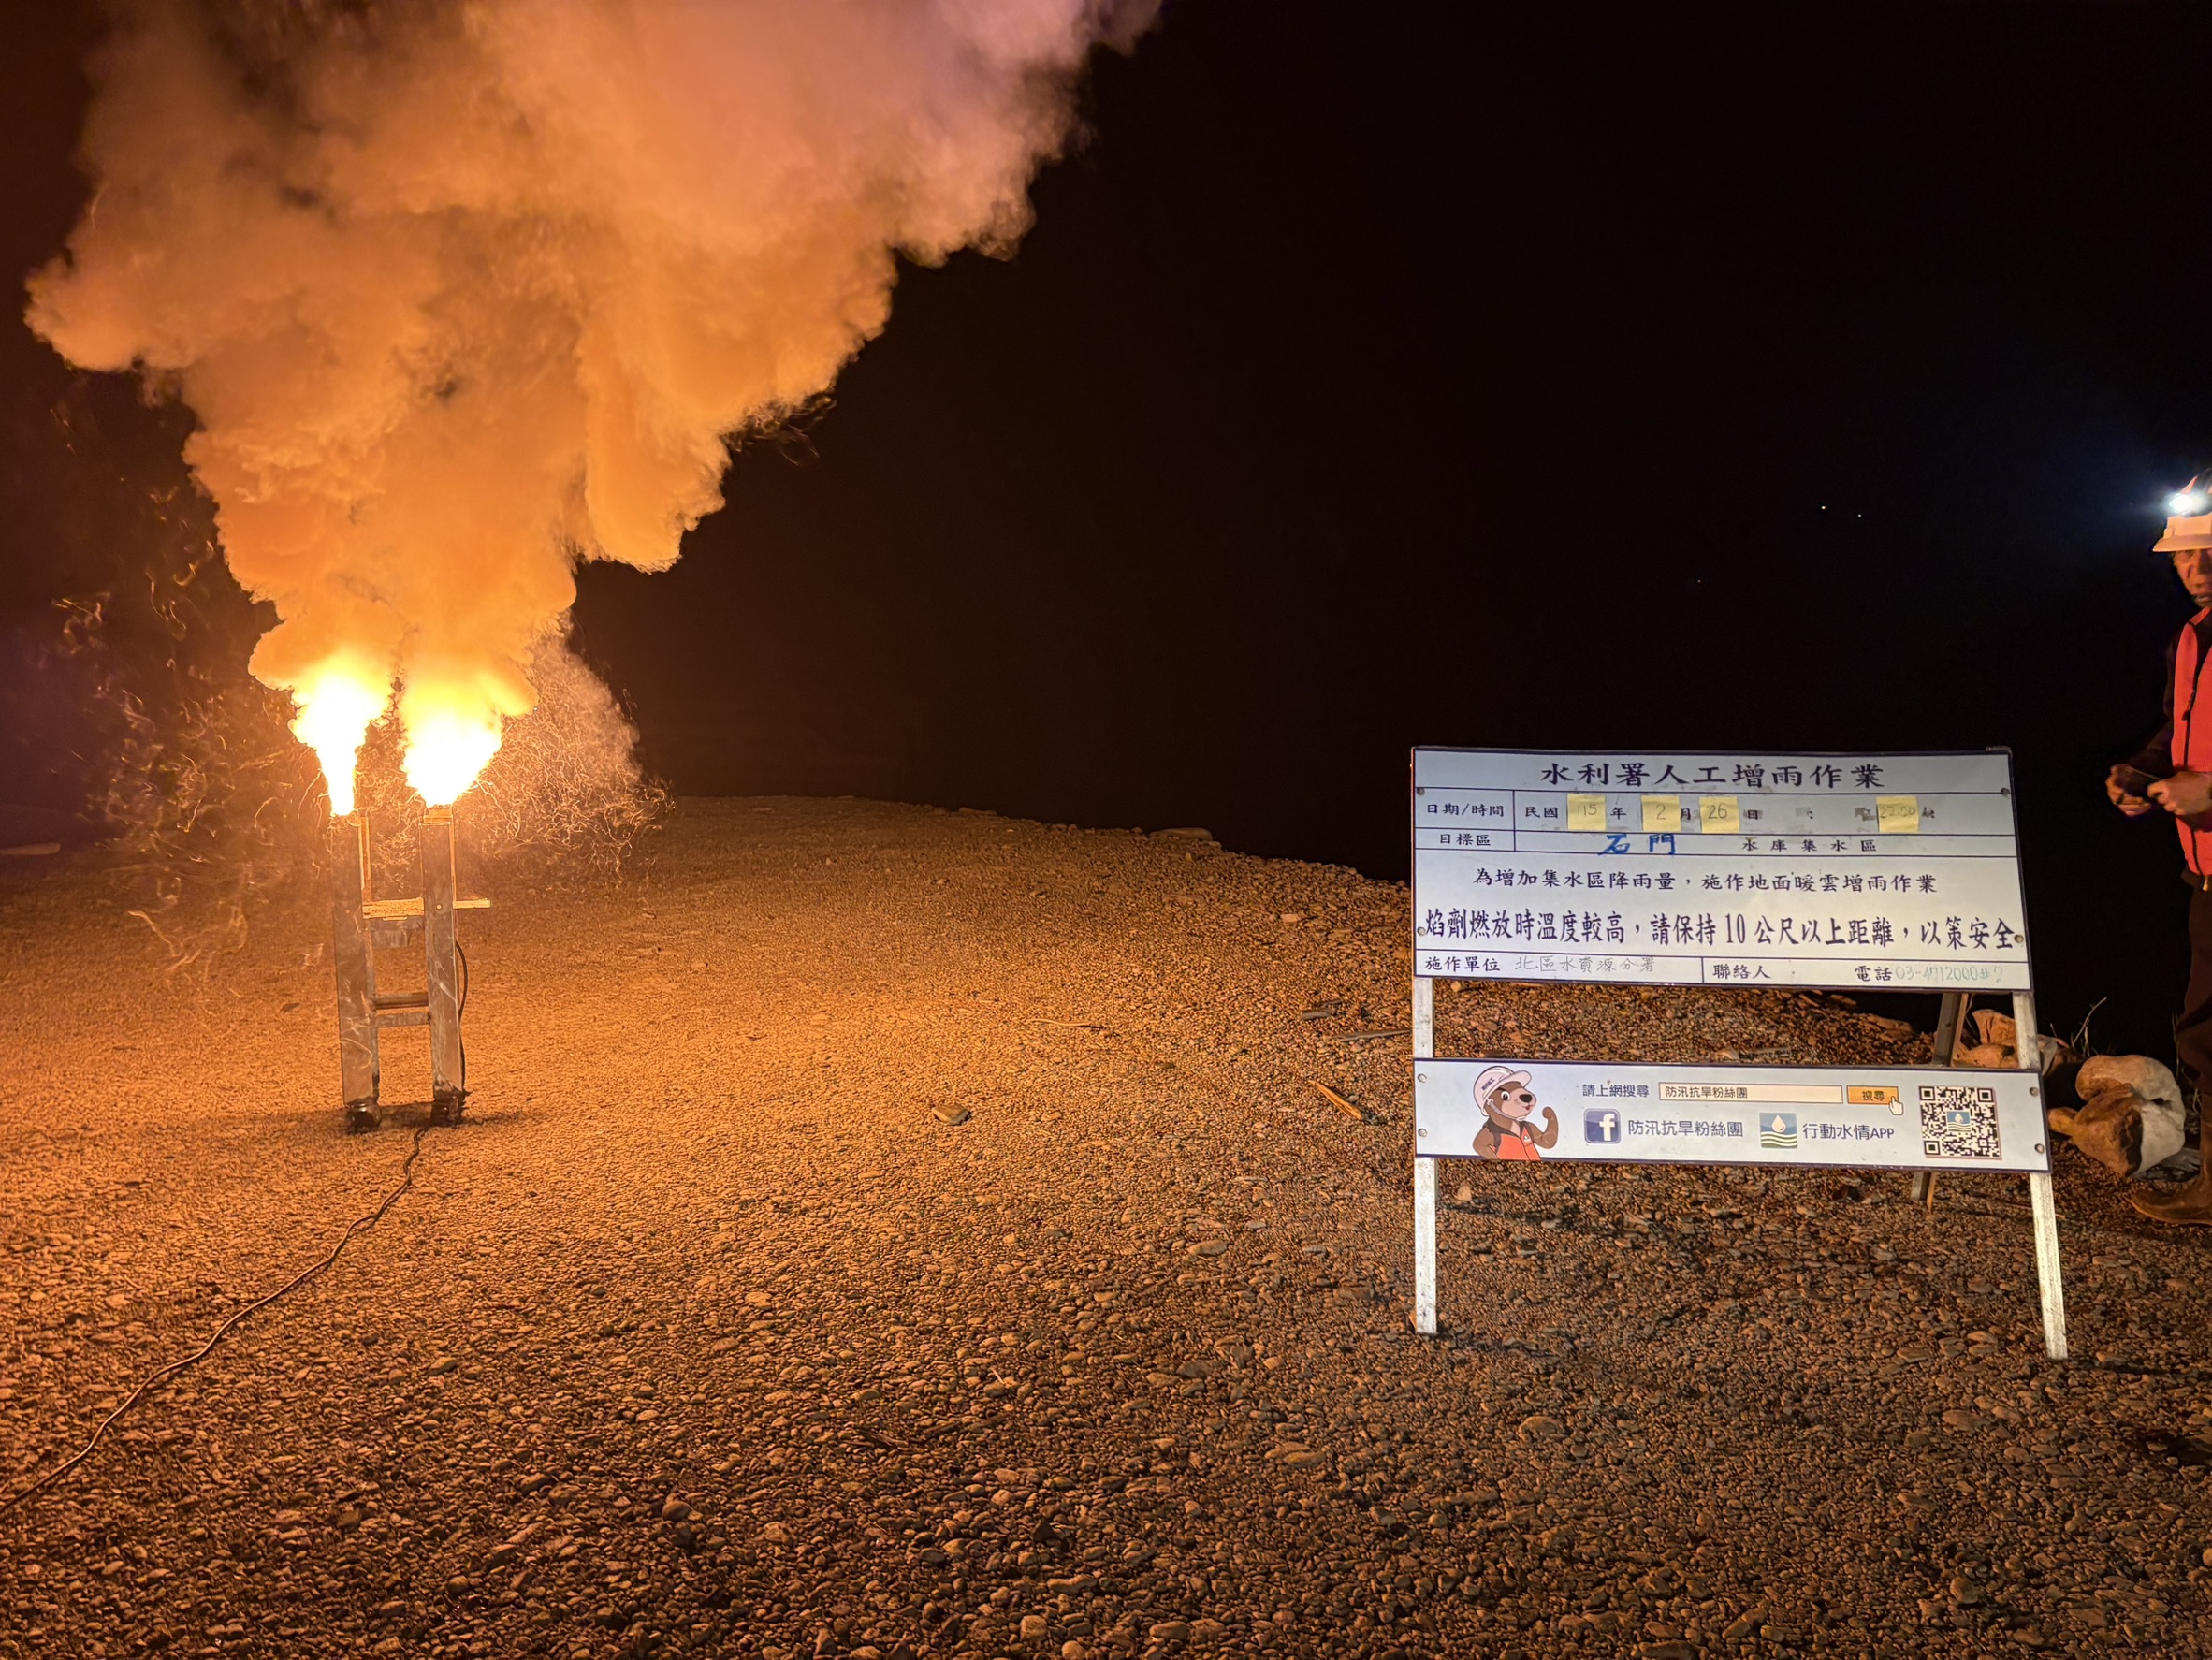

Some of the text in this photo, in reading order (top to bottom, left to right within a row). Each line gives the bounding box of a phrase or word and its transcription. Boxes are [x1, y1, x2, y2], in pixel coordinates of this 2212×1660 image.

[1540, 763, 1885, 788] 水利署人工增雨作業
[1426, 803, 1504, 817] 日期/時間
[1524, 805, 1559, 818] 民國
[1578, 804, 1597, 817] 115
[1610, 807, 1627, 820] 年
[1656, 804, 1666, 821] 2
[1681, 808, 1691, 821] 月
[1706, 802, 1728, 819] 26
[1747, 809, 1759, 820] 日
[1440, 833, 1492, 846] 目標區
[1597, 833, 1676, 855] 石門
[1742, 837, 1877, 852] 水庫集水區
[1473, 868, 1938, 893] 為增加集水區降雨量，施作地面暖雲增雨作業
[1424, 956, 1501, 972] 施作單位
[1514, 954, 1655, 973] 北區水資源分署
[1712, 964, 1773, 980] 聯絡人
[1855, 965, 1893, 982] 電話
[1581, 1084, 1650, 1099] 請上網搜尋
[1665, 1085, 1748, 1099] 防汛抗旱粉絲團
[1861, 1089, 1887, 1102] 搜尋
[1627, 1119, 1743, 1138] 防汛抗旱粉絲團
[1802, 1123, 1895, 1141] 行動水情APP
